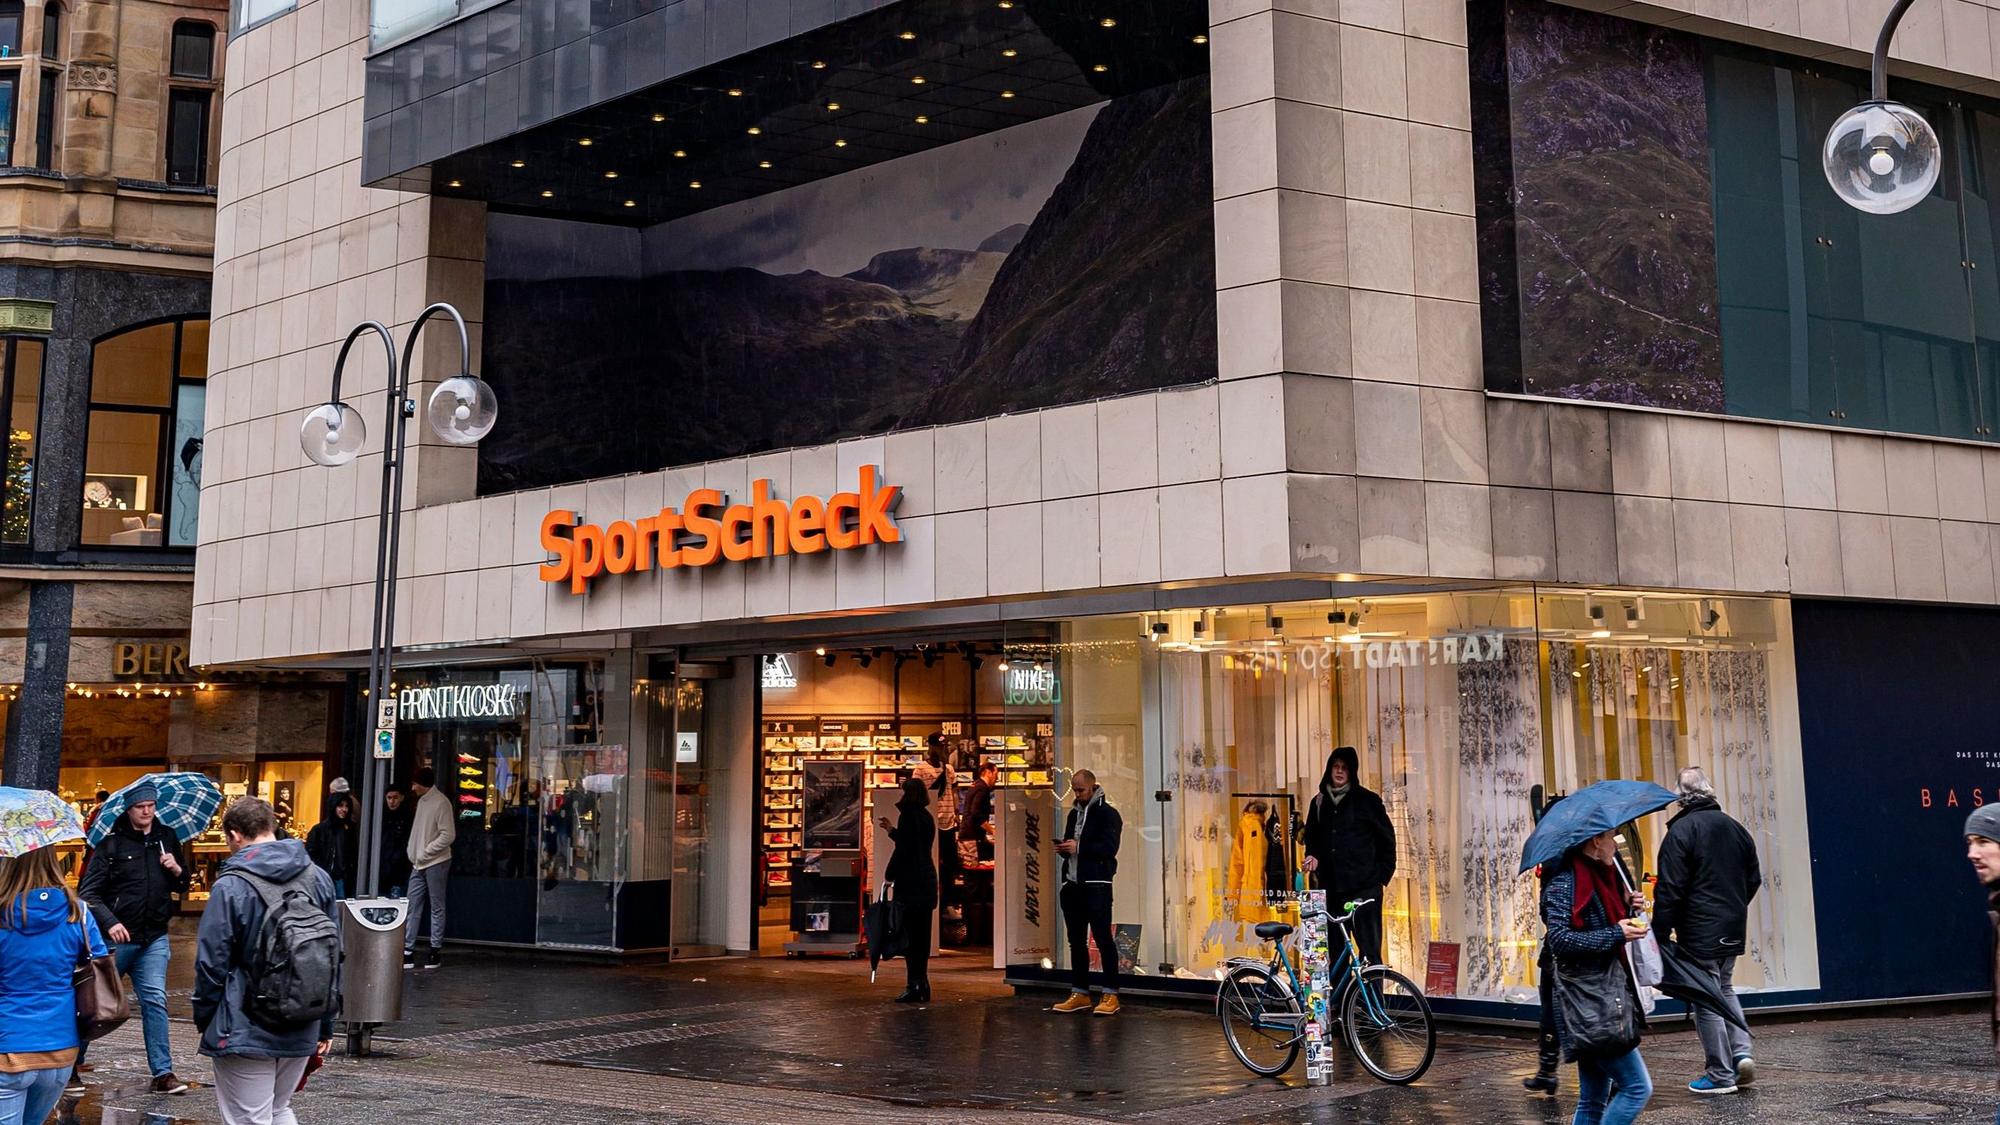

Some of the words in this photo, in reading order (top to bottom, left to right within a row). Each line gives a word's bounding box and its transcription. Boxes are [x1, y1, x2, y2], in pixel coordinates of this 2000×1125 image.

[539, 464, 904, 595] SportScheck
[761, 678, 797, 688] adidas
[1015, 669, 1047, 691] NIKE
[400, 686, 453, 720] PRINT
[453, 684, 511, 718] KIOSK
[1956, 751, 1972, 759] DAS
[1976, 751, 1989, 759] IST
[1921, 788, 2000, 808] BAS
[1025, 808, 1041, 853] MORE
[1276, 889, 1297, 898] DAYS
